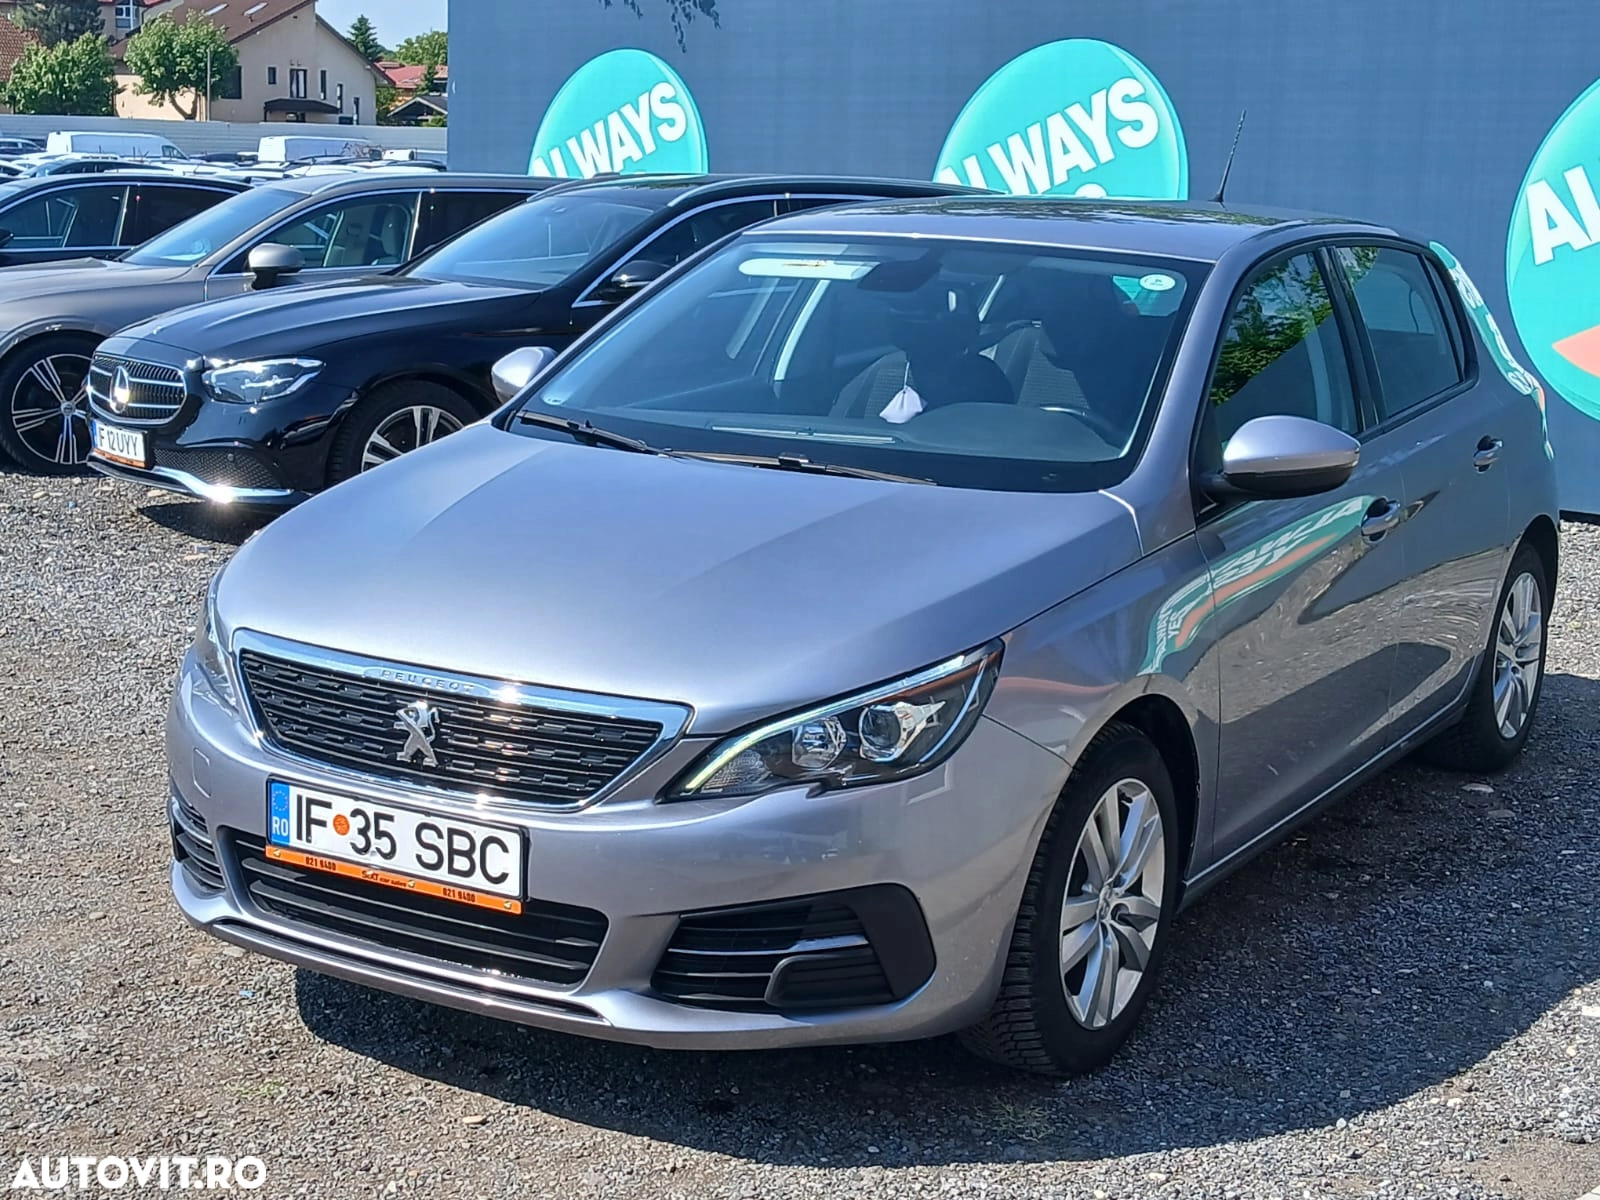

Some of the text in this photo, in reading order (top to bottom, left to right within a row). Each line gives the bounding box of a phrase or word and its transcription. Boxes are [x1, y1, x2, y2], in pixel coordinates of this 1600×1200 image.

[938, 77, 1159, 194] WAYS
[380, 669, 475, 692] PEUGEOT
[272, 816, 289, 837] RO
[296, 794, 510, 885] IF 35 SBC
[442, 887, 456, 898] 021
